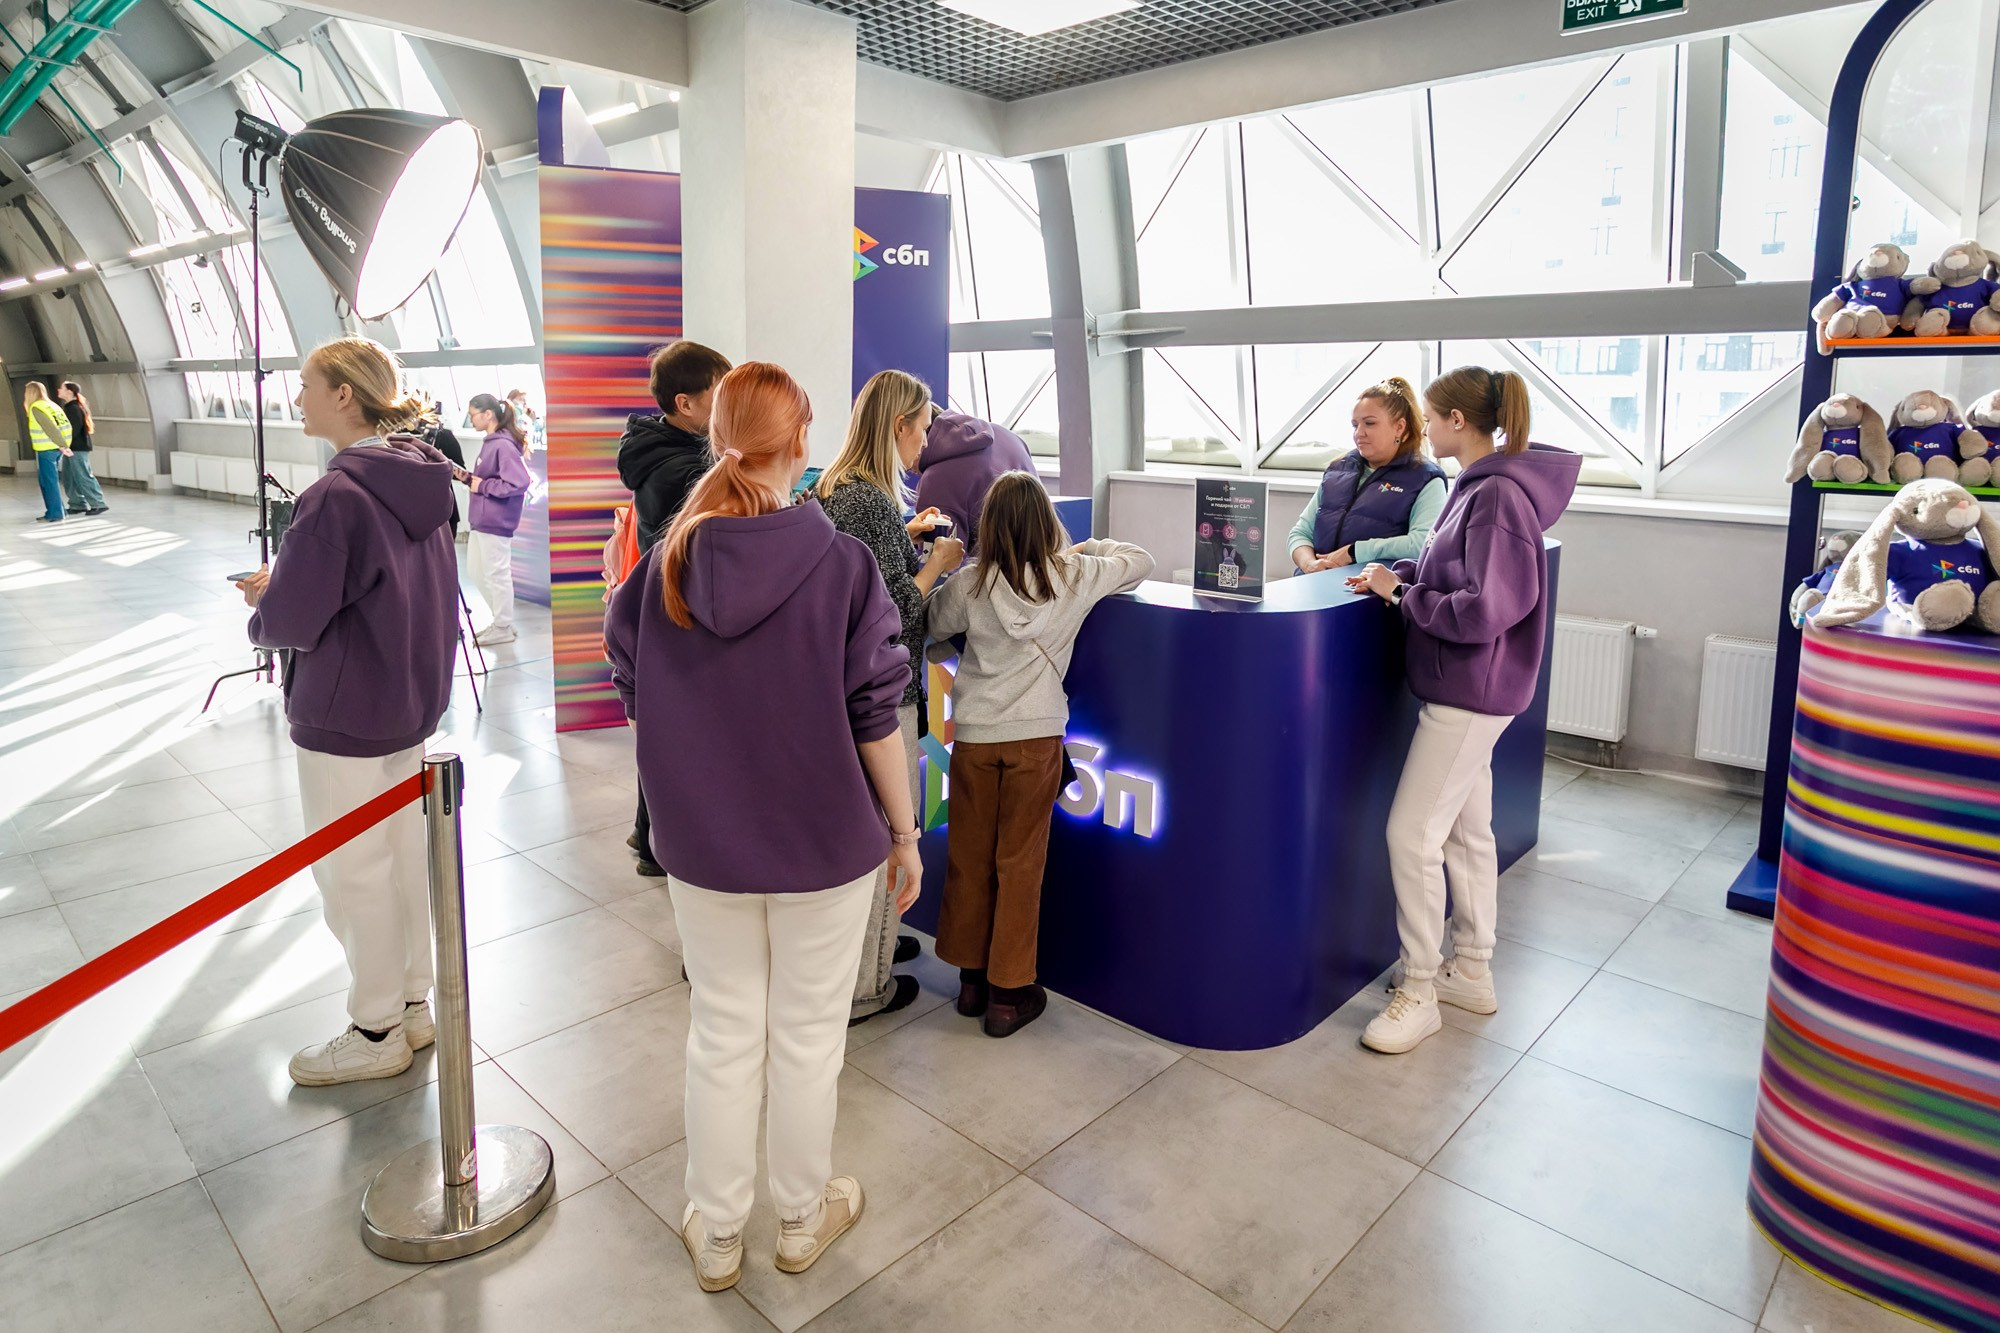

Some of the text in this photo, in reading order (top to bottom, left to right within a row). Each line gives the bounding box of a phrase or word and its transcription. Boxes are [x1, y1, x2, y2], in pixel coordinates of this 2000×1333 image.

[1577, 5, 1607, 20] EXIT
[320, 207, 357, 254] SmallRig
[882, 244, 929, 266] сбп
[1957, 565, 1980, 575] сбп
[1055, 743, 1154, 839] бп
